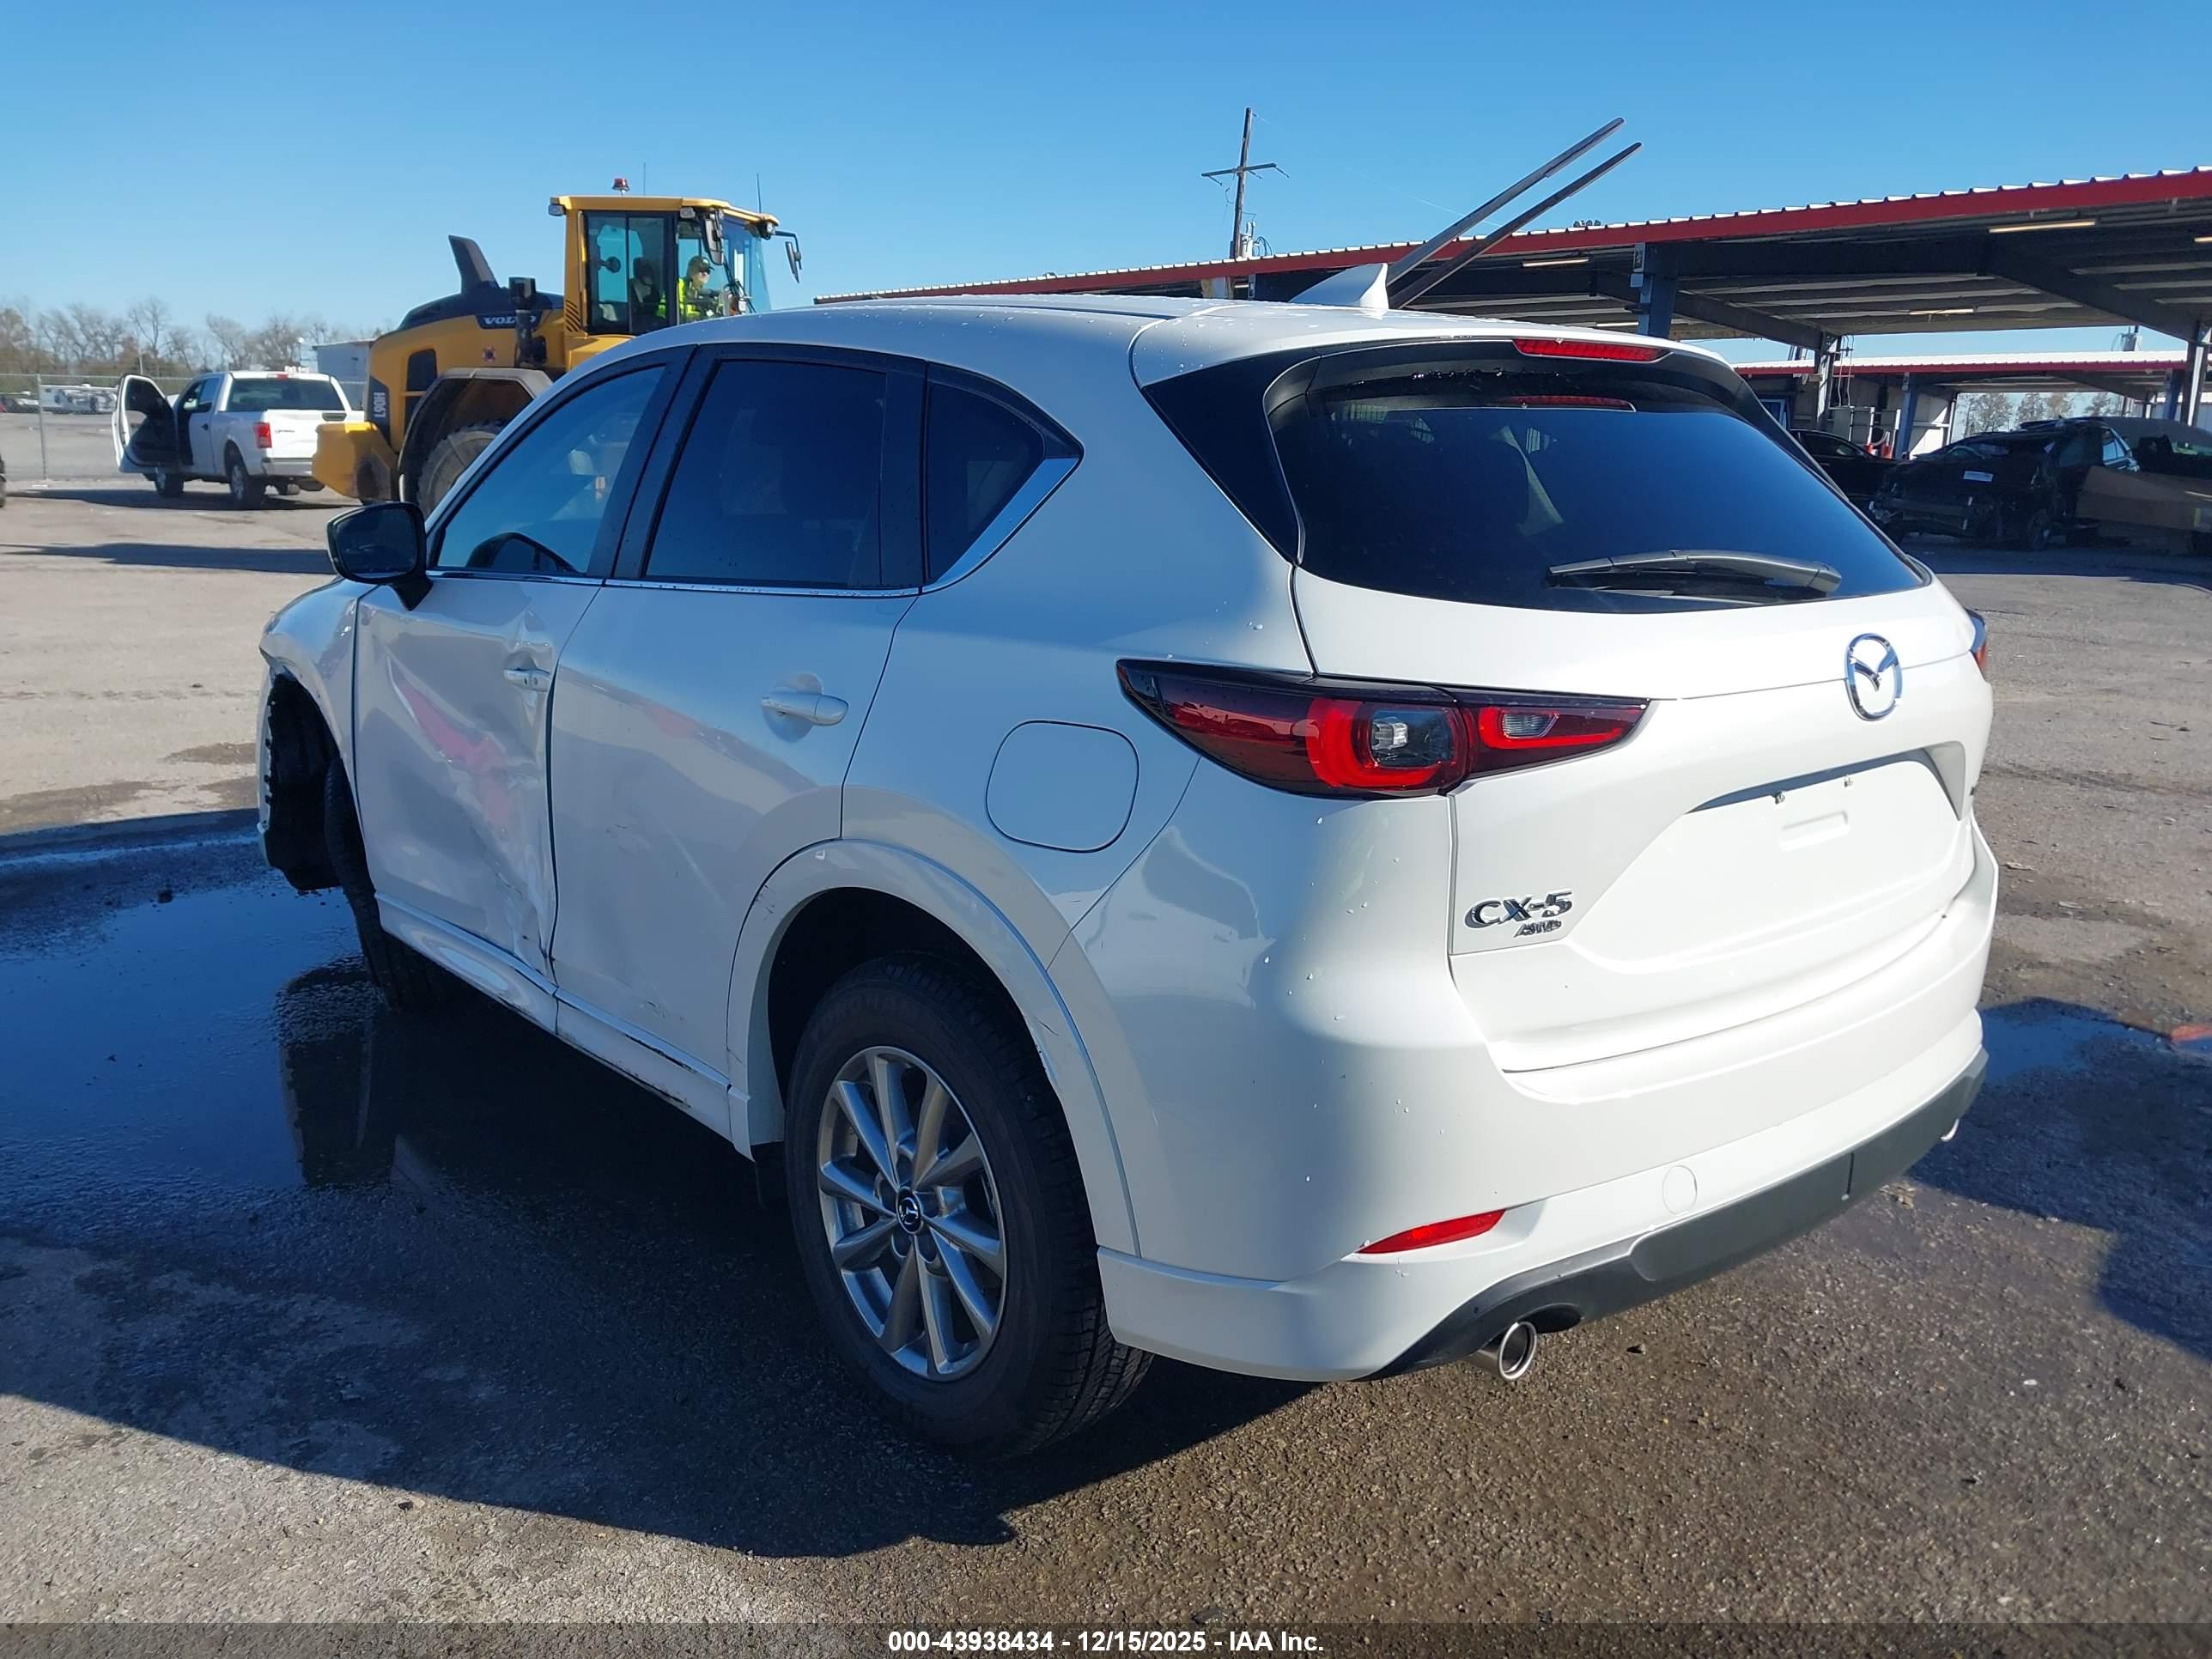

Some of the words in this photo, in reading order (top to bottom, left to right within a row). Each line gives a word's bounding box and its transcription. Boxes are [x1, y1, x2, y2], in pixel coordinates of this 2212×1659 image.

[483, 316, 537, 325] VOLO
[374, 392, 386, 418] L90H
[1464, 890, 1573, 929] CX-5
[1514, 920, 1562, 939] AWD
